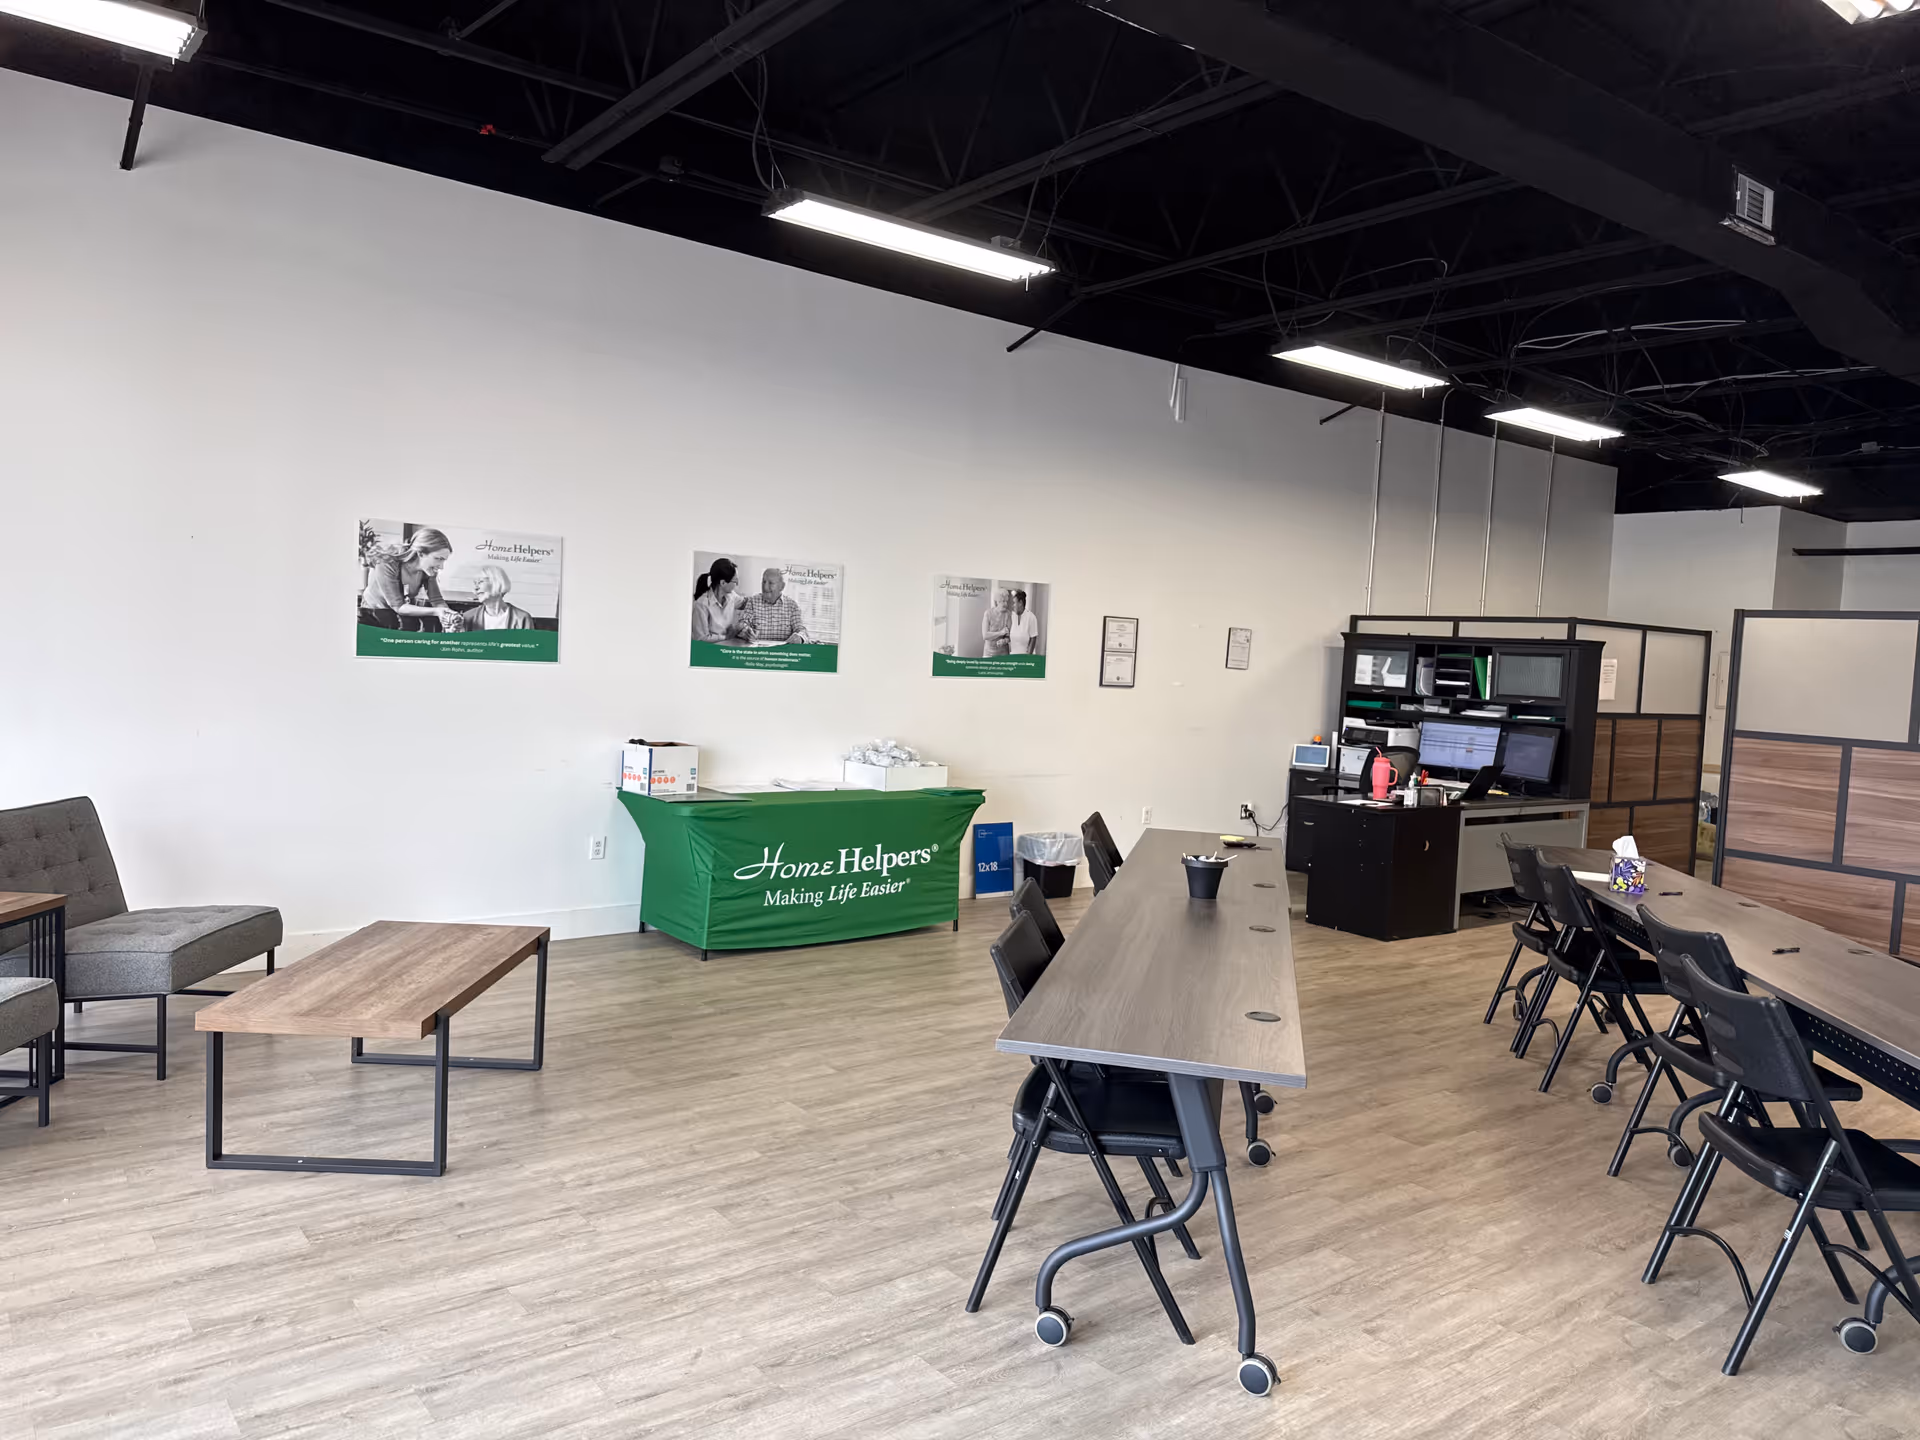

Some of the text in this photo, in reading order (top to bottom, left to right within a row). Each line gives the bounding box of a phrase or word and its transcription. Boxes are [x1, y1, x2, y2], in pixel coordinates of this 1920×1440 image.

[475, 539, 512, 552] Home
[488, 554, 509, 562] Making
[780, 565, 806, 578] Home
[939, 580, 962, 590] Home
[734, 842, 834, 880] Home
[978, 861, 998, 872] 12x18
[764, 888, 824, 908] Making
[828, 883, 857, 904] Life
